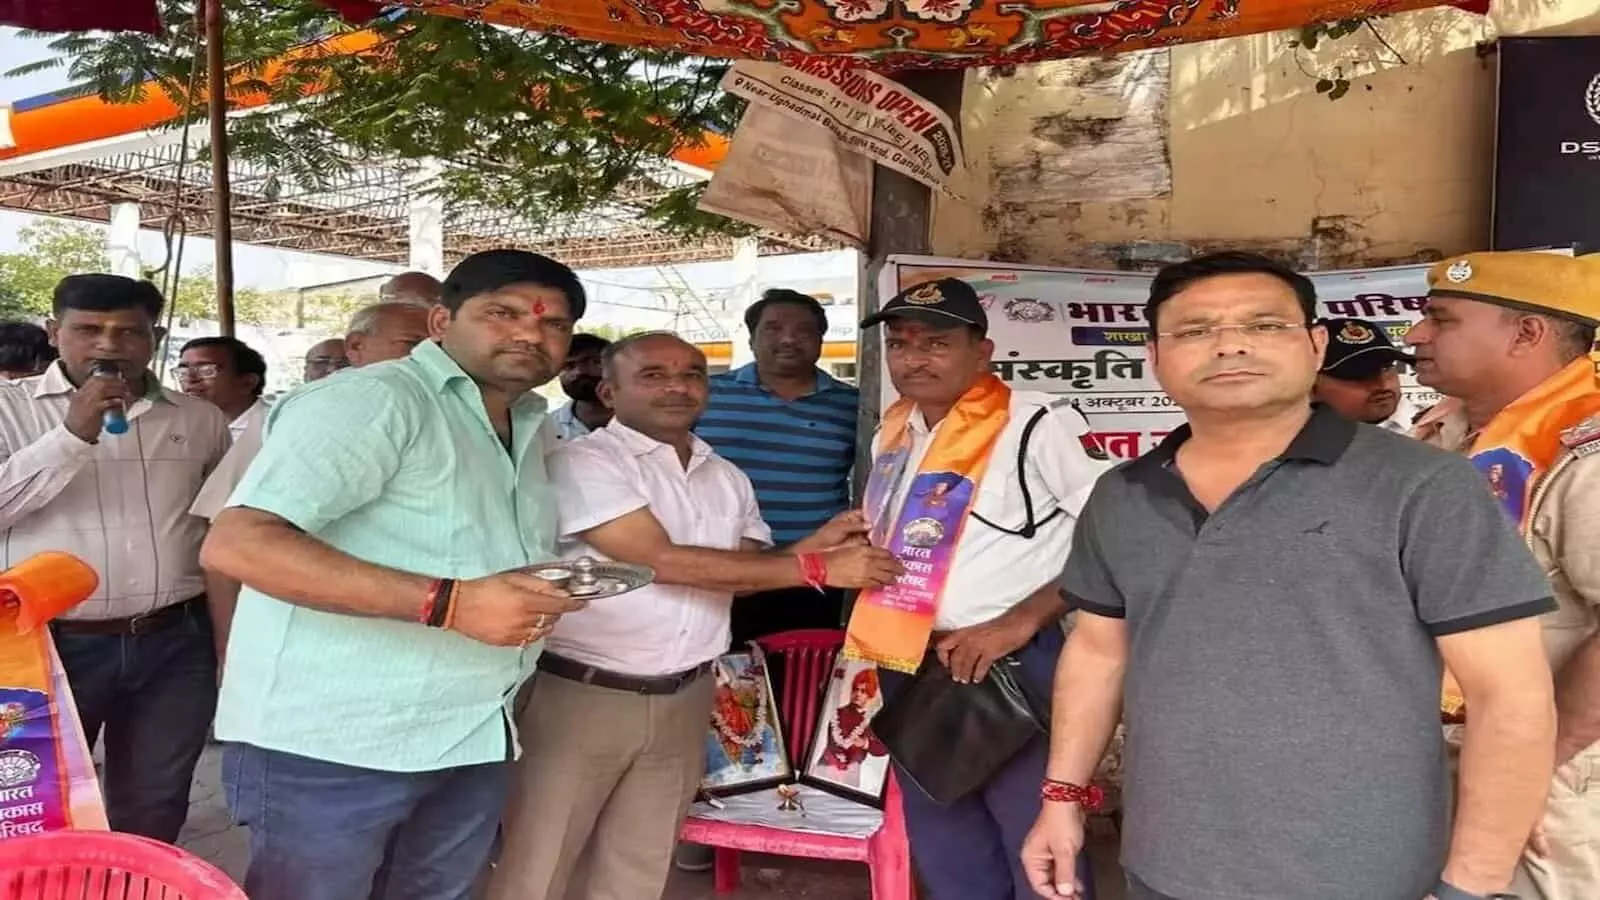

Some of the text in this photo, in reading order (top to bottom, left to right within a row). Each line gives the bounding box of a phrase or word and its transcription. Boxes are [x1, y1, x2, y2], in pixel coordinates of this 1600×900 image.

[742, 81, 769, 97] Near
[780, 75, 829, 99] Classes:
[876, 90, 938, 132] OPEN
[1067, 302, 1149, 322] भार
[1103, 330, 1147, 343] शाखा
[1086, 397, 1147, 410] अक्टूबर
